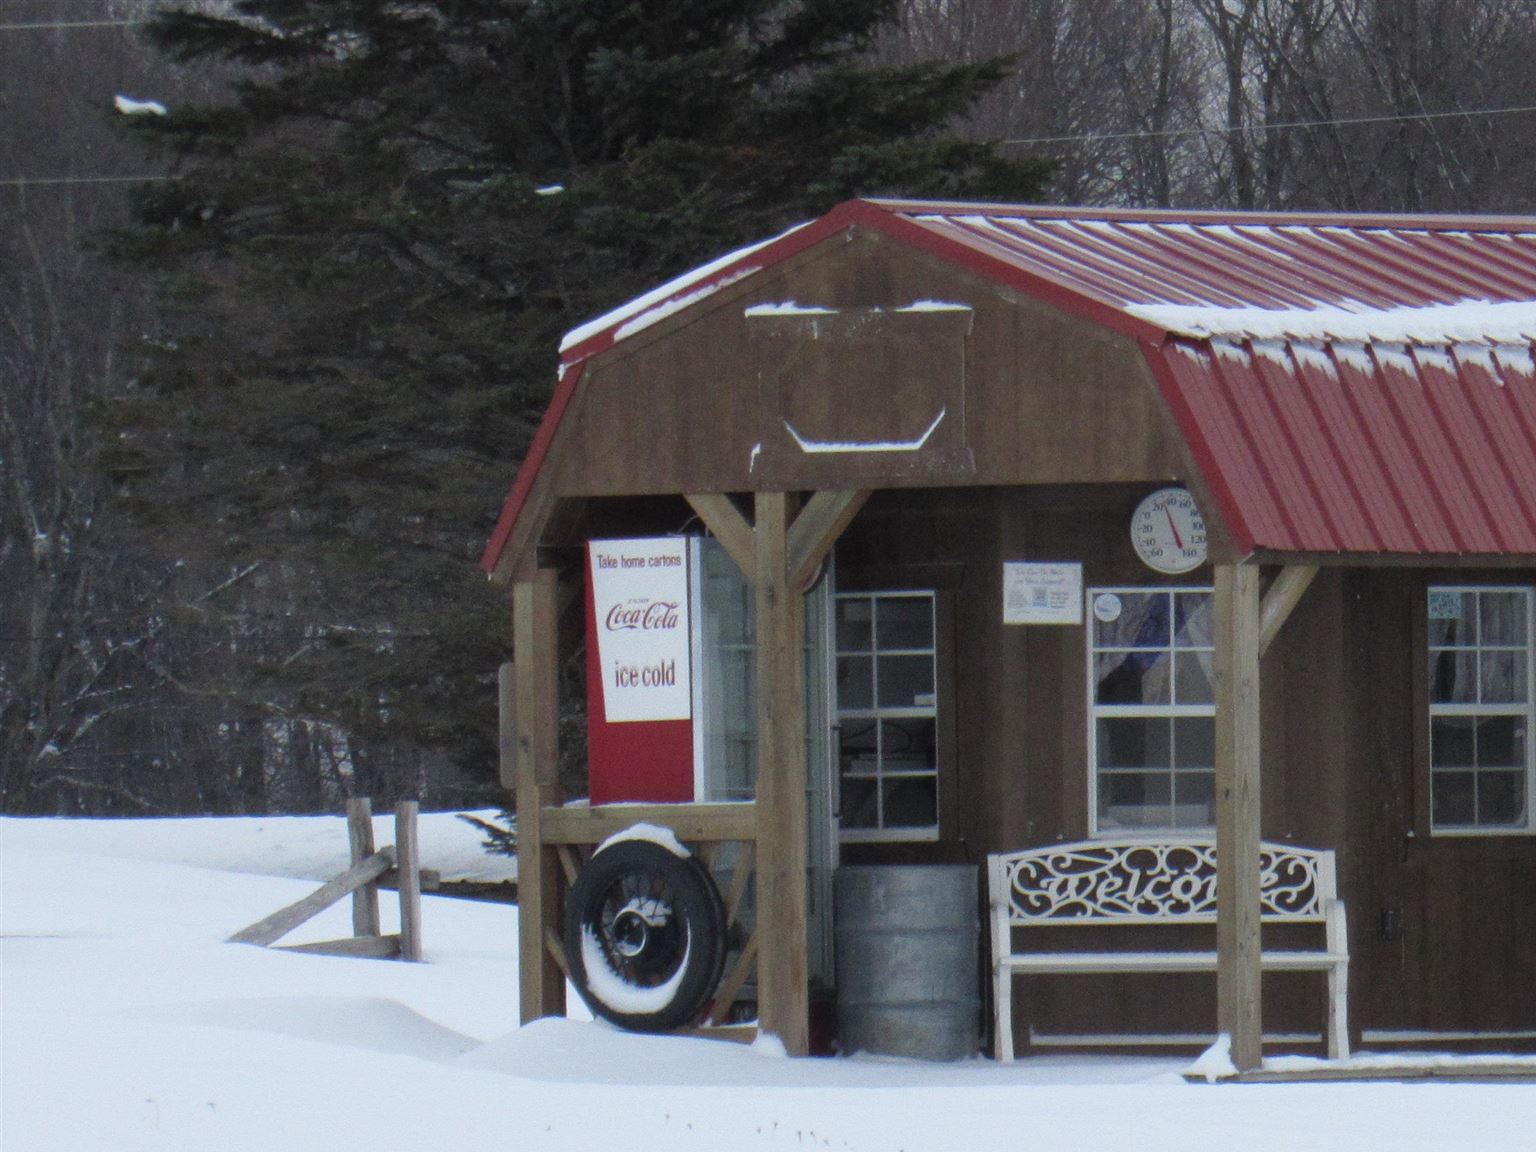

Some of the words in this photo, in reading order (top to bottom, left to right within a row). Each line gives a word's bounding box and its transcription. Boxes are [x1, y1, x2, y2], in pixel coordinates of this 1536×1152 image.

[597, 554, 618, 569] Take
[621, 554, 646, 568] home
[648, 554, 682, 568] cartons
[615, 661, 639, 687] ice
[642, 659, 676, 687] cold
